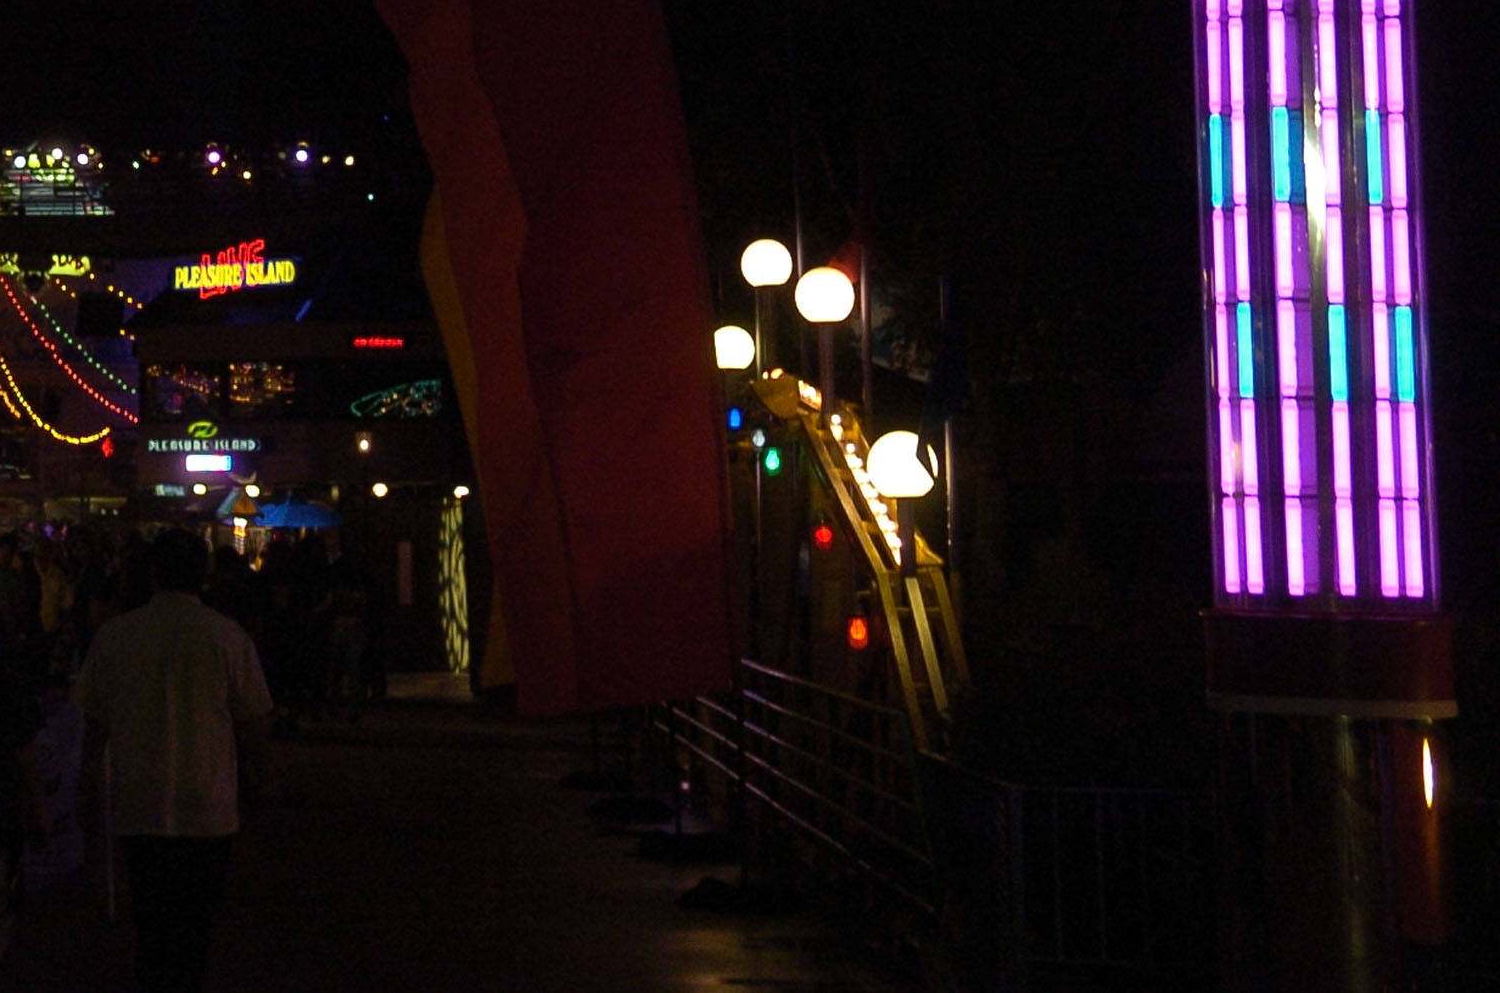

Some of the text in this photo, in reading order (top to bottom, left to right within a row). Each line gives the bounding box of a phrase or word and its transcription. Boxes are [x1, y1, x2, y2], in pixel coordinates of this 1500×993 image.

[173, 259, 296, 290] PLEASURE ISLAND
[148, 439, 257, 452] PLEASURE ISLAND
